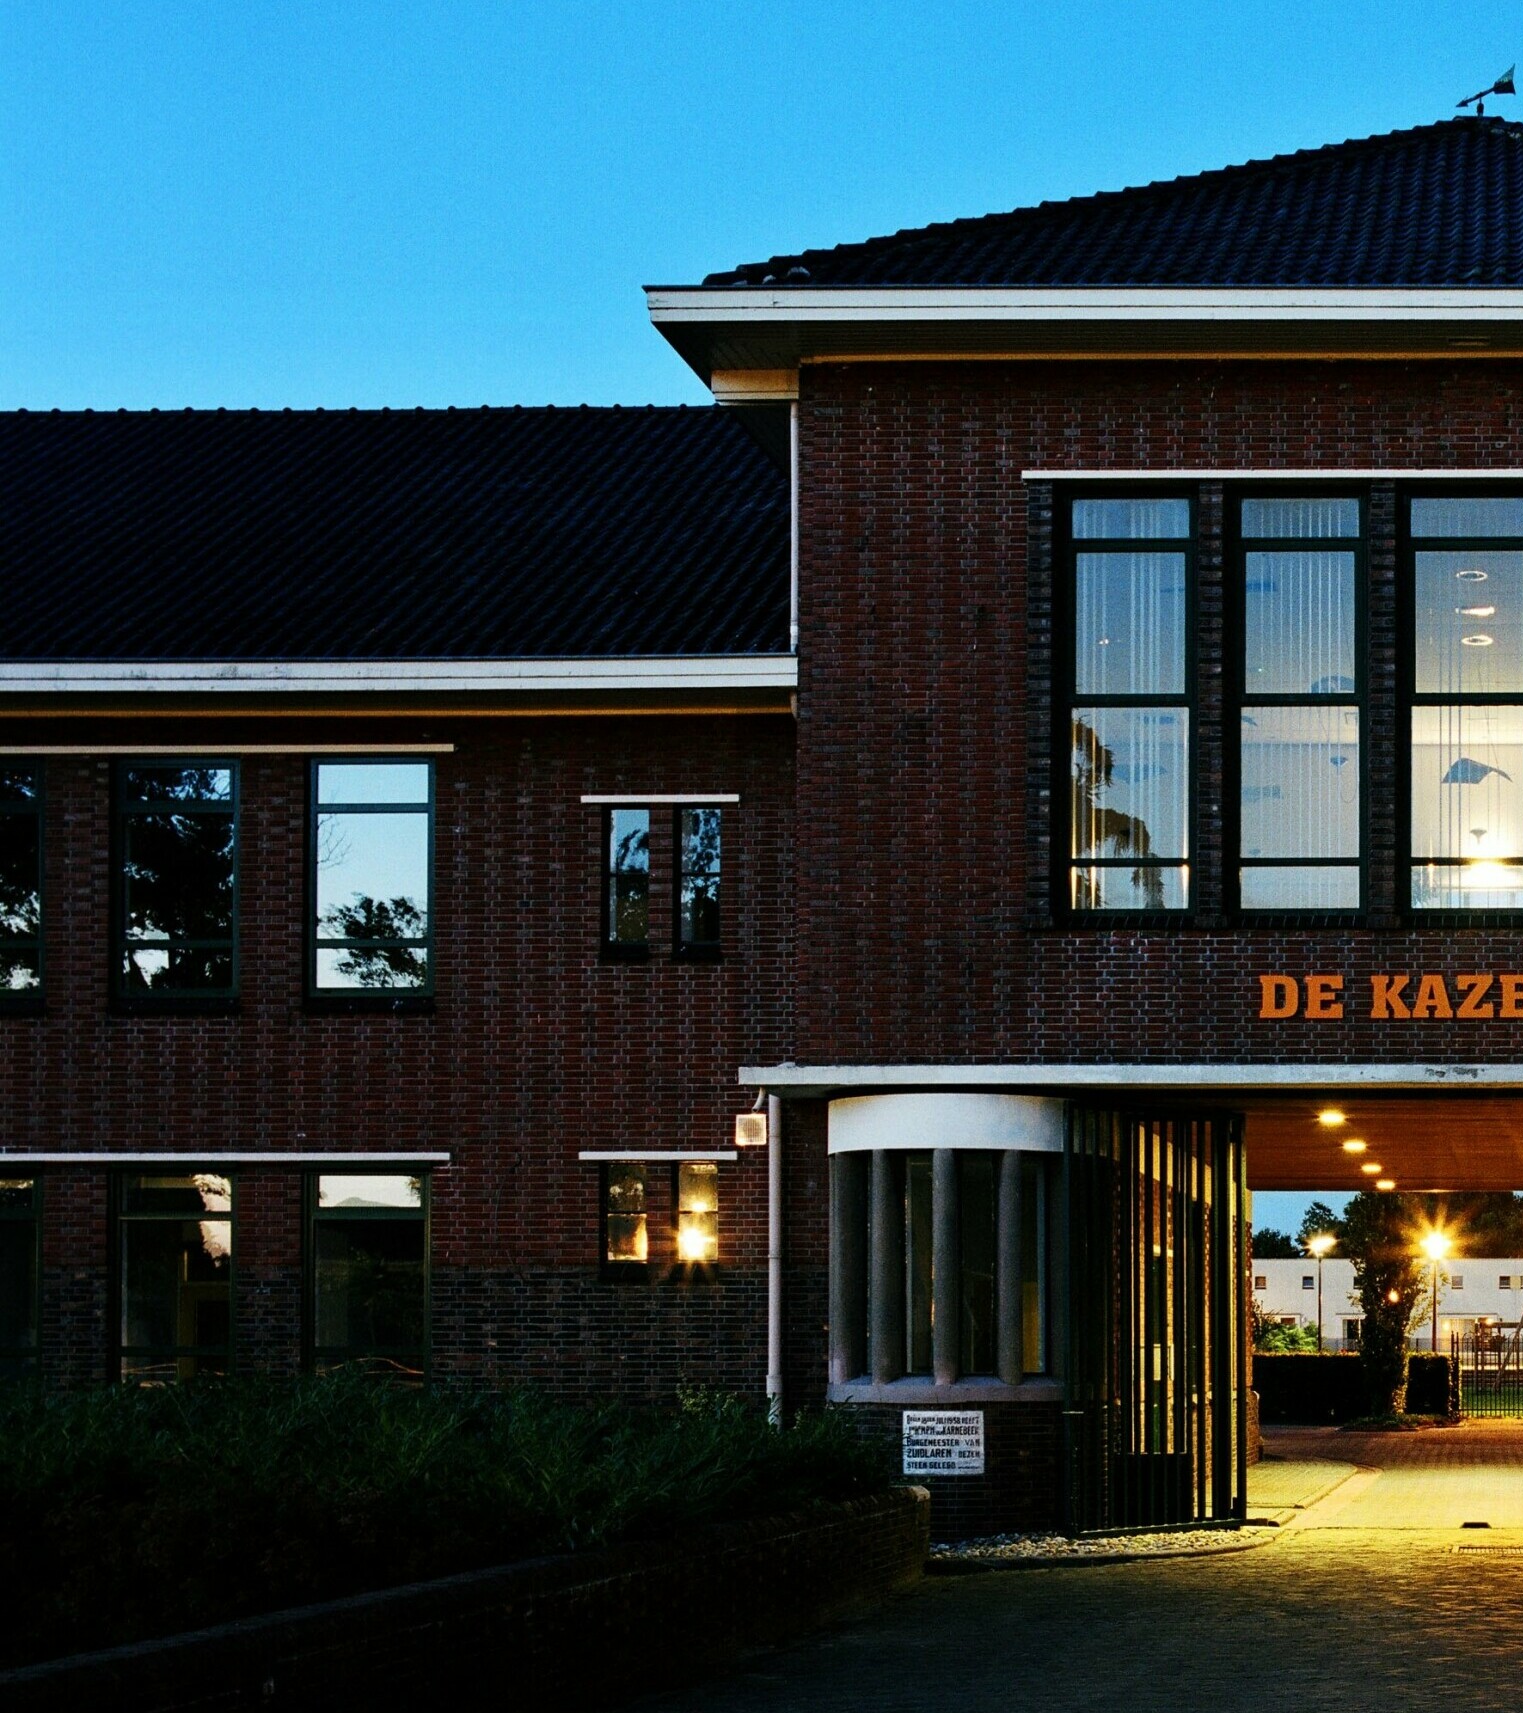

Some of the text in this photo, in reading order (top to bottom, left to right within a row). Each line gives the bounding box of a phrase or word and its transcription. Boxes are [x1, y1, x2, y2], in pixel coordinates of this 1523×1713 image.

[1258, 974, 1344, 1019] DE
[907, 1438, 980, 1446] BURGEMEESTER VAN
[907, 1448, 980, 1458] ZUIDLAREN DEZEN
[907, 1461, 927, 1469] STEEN
